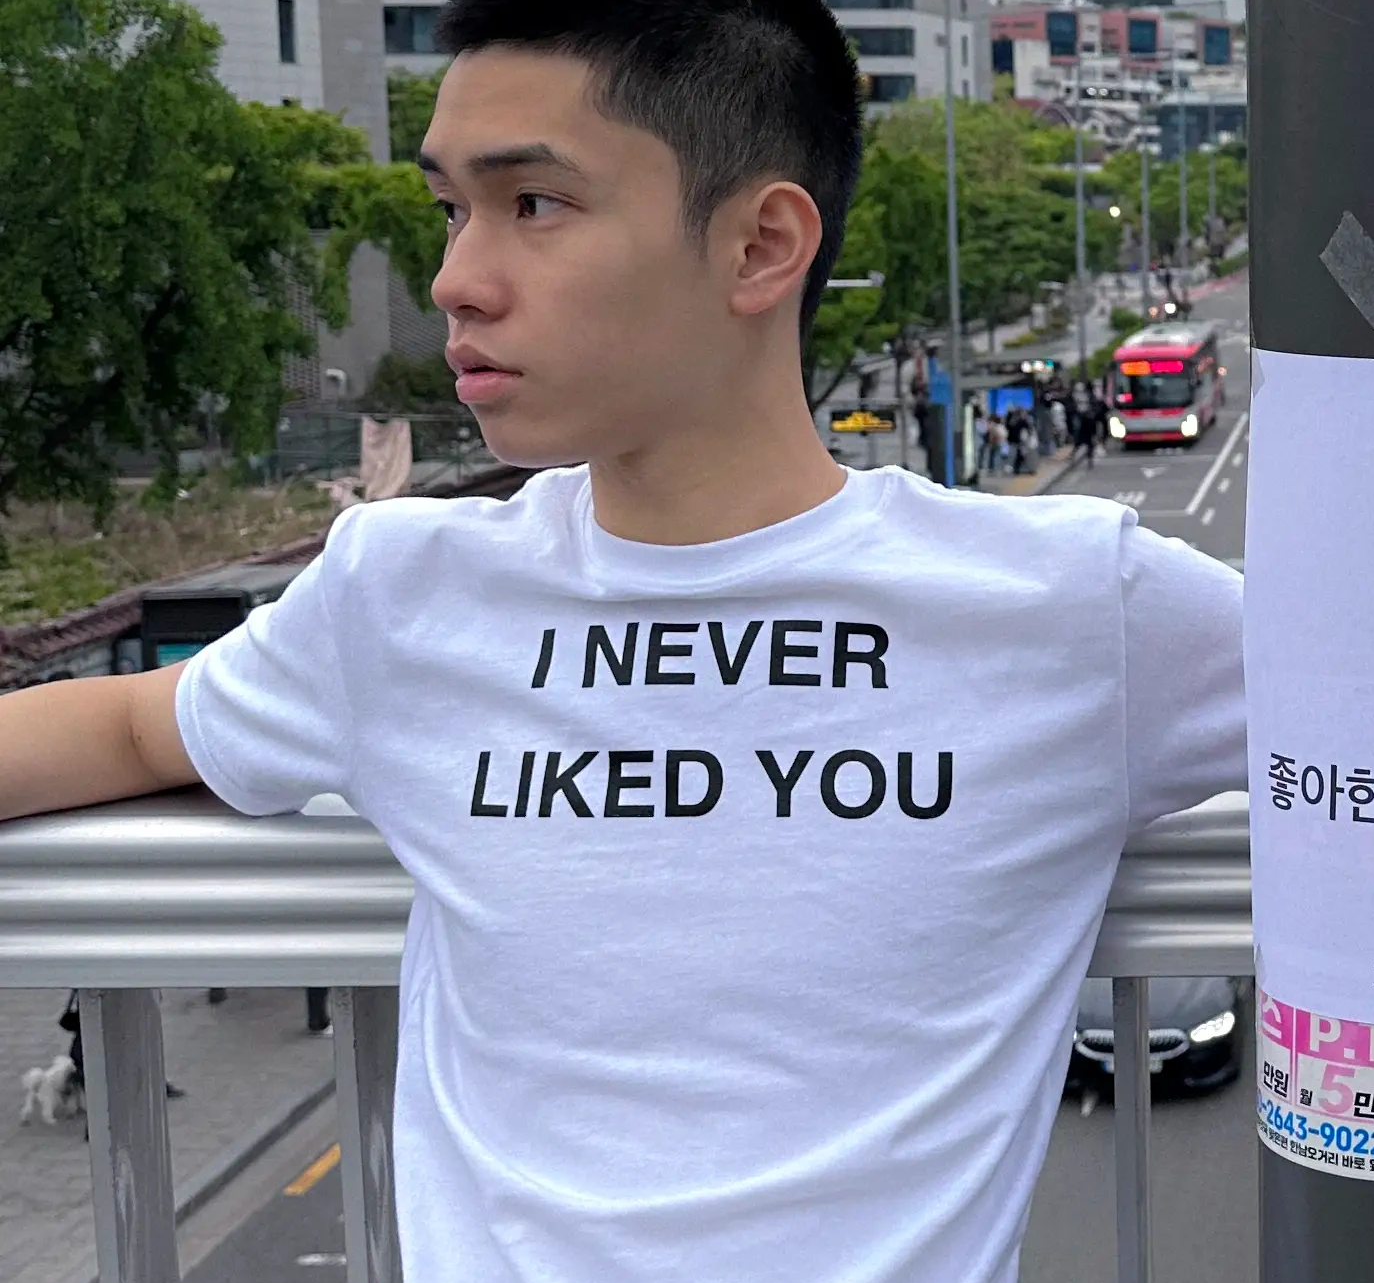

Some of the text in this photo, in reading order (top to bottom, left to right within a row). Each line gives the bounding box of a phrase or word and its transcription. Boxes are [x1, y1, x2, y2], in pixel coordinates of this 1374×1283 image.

[531, 620, 890, 689] I NEVER
[470, 749, 953, 819] LIKED YOU
